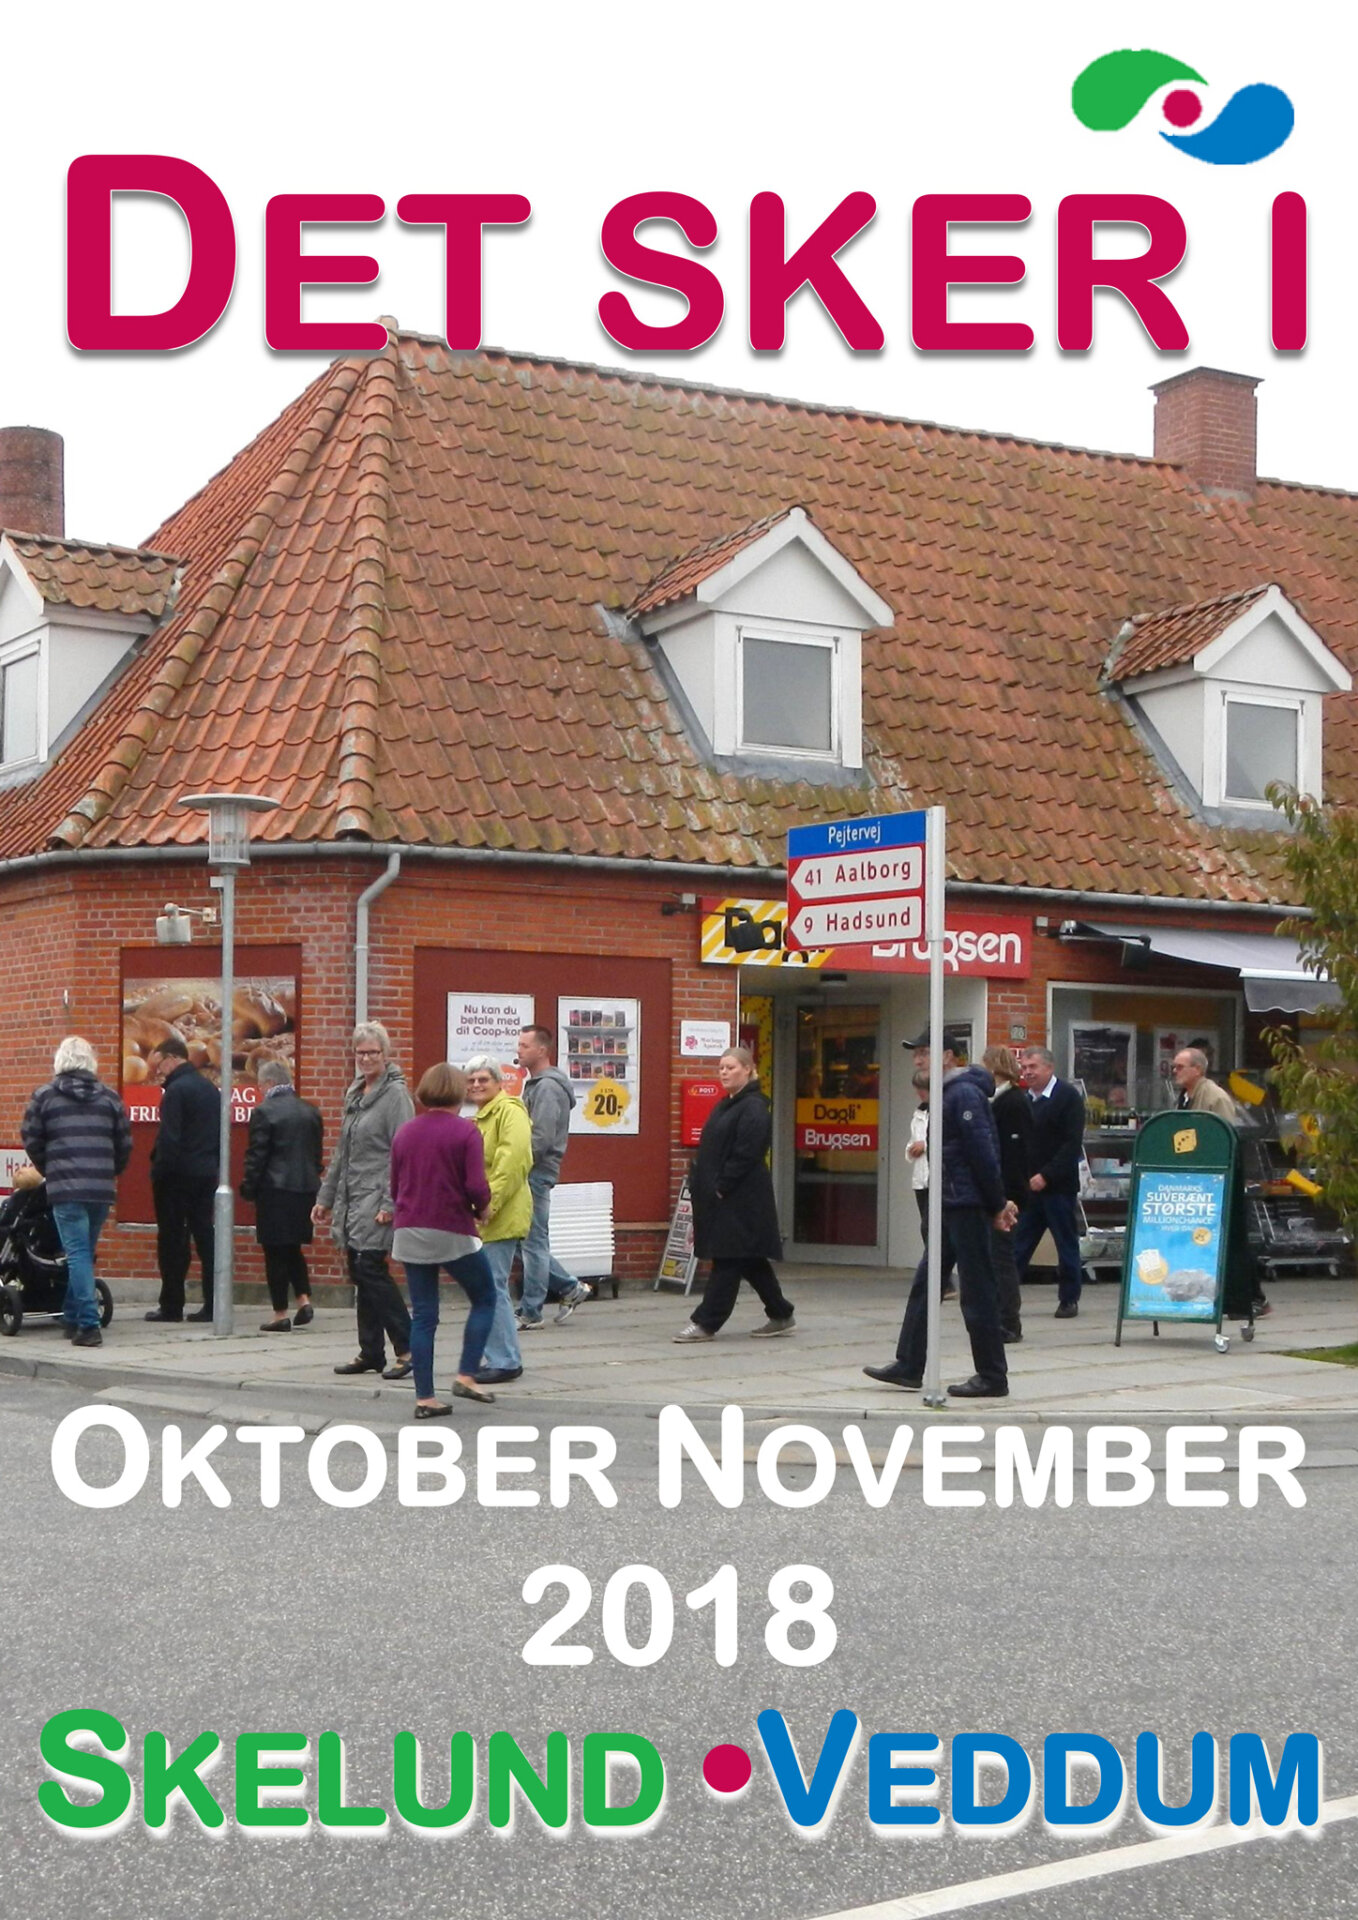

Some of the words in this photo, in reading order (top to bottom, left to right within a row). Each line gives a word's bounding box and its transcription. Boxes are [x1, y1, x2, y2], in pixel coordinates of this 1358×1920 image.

[828, 821, 881, 847] Pejtervej
[805, 868, 821, 886] 41
[835, 861, 911, 883] Aalborg
[804, 916, 813, 933] 9
[826, 906, 911, 932] Hadsund
[464, 1005, 478, 1014] Nu
[481, 1005, 500, 1014] kan
[503, 1006, 517, 1015] du
[460, 1016, 494, 1025] betale
[497, 1016, 521, 1026] med
[456, 1027, 469, 1035] dit
[805, 1128, 870, 1150] Brugsen
[1146, 1192, 1214, 1203] SUVERÆNT
[1142, 1202, 1217, 1216] STØRSTE
